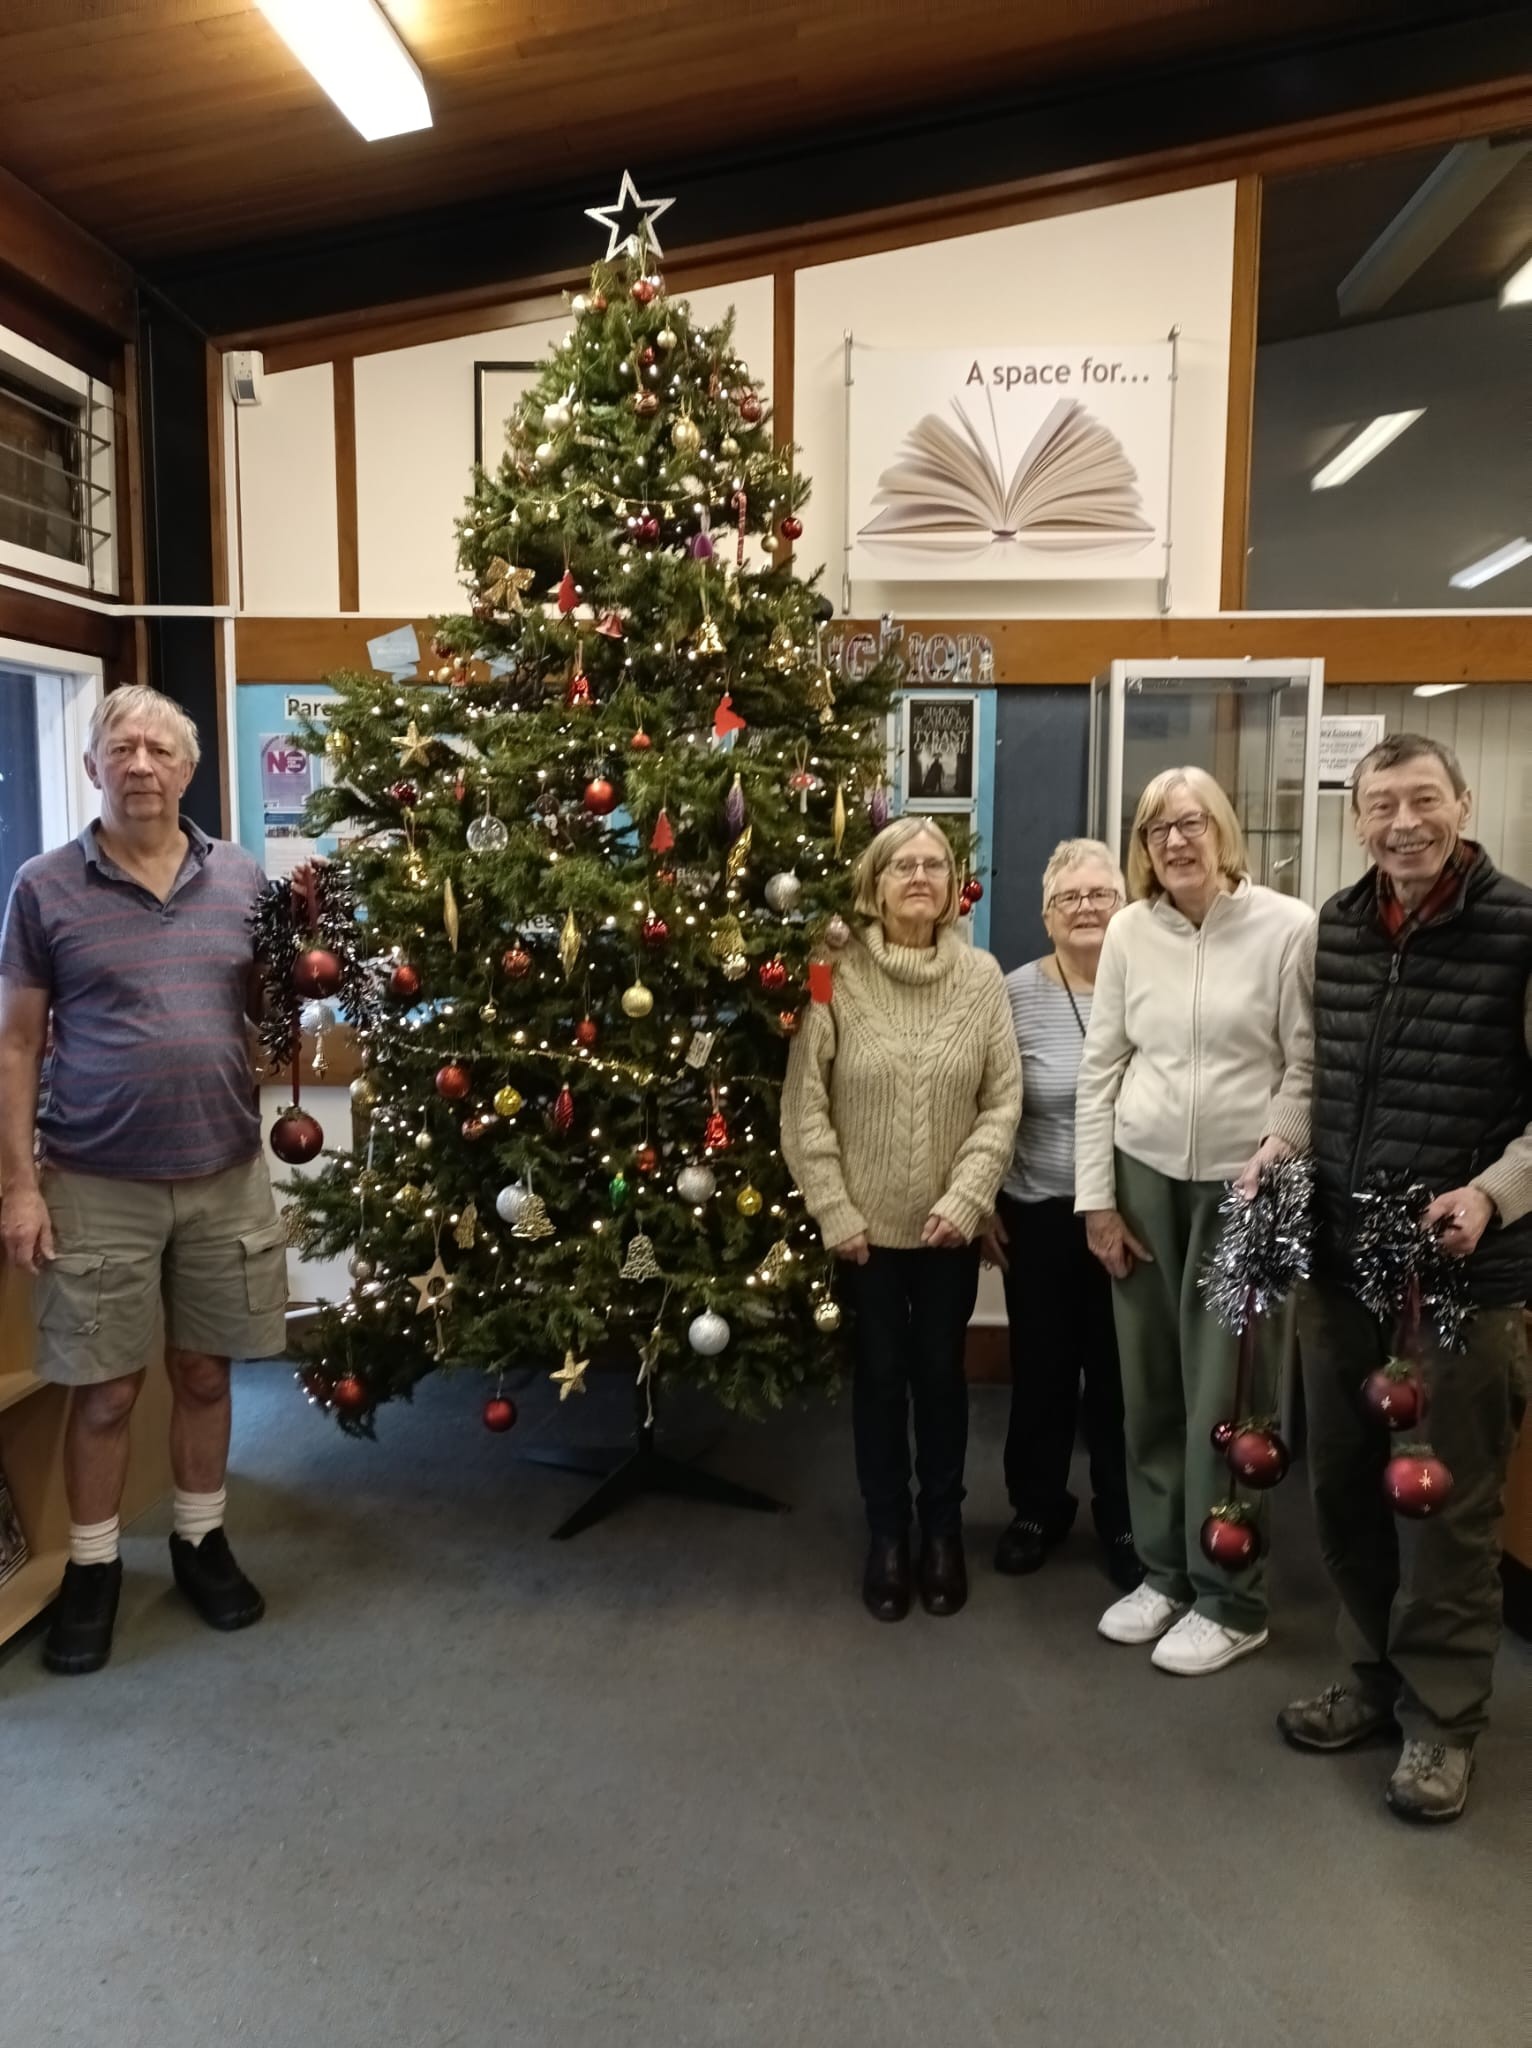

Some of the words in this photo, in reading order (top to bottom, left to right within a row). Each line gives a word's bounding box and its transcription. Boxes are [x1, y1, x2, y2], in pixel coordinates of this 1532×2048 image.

[966, 359, 984, 386] A
[993, 363, 1071, 392] space
[1081, 356, 1150, 384] for...
[913, 730, 970, 743] TYRANT
